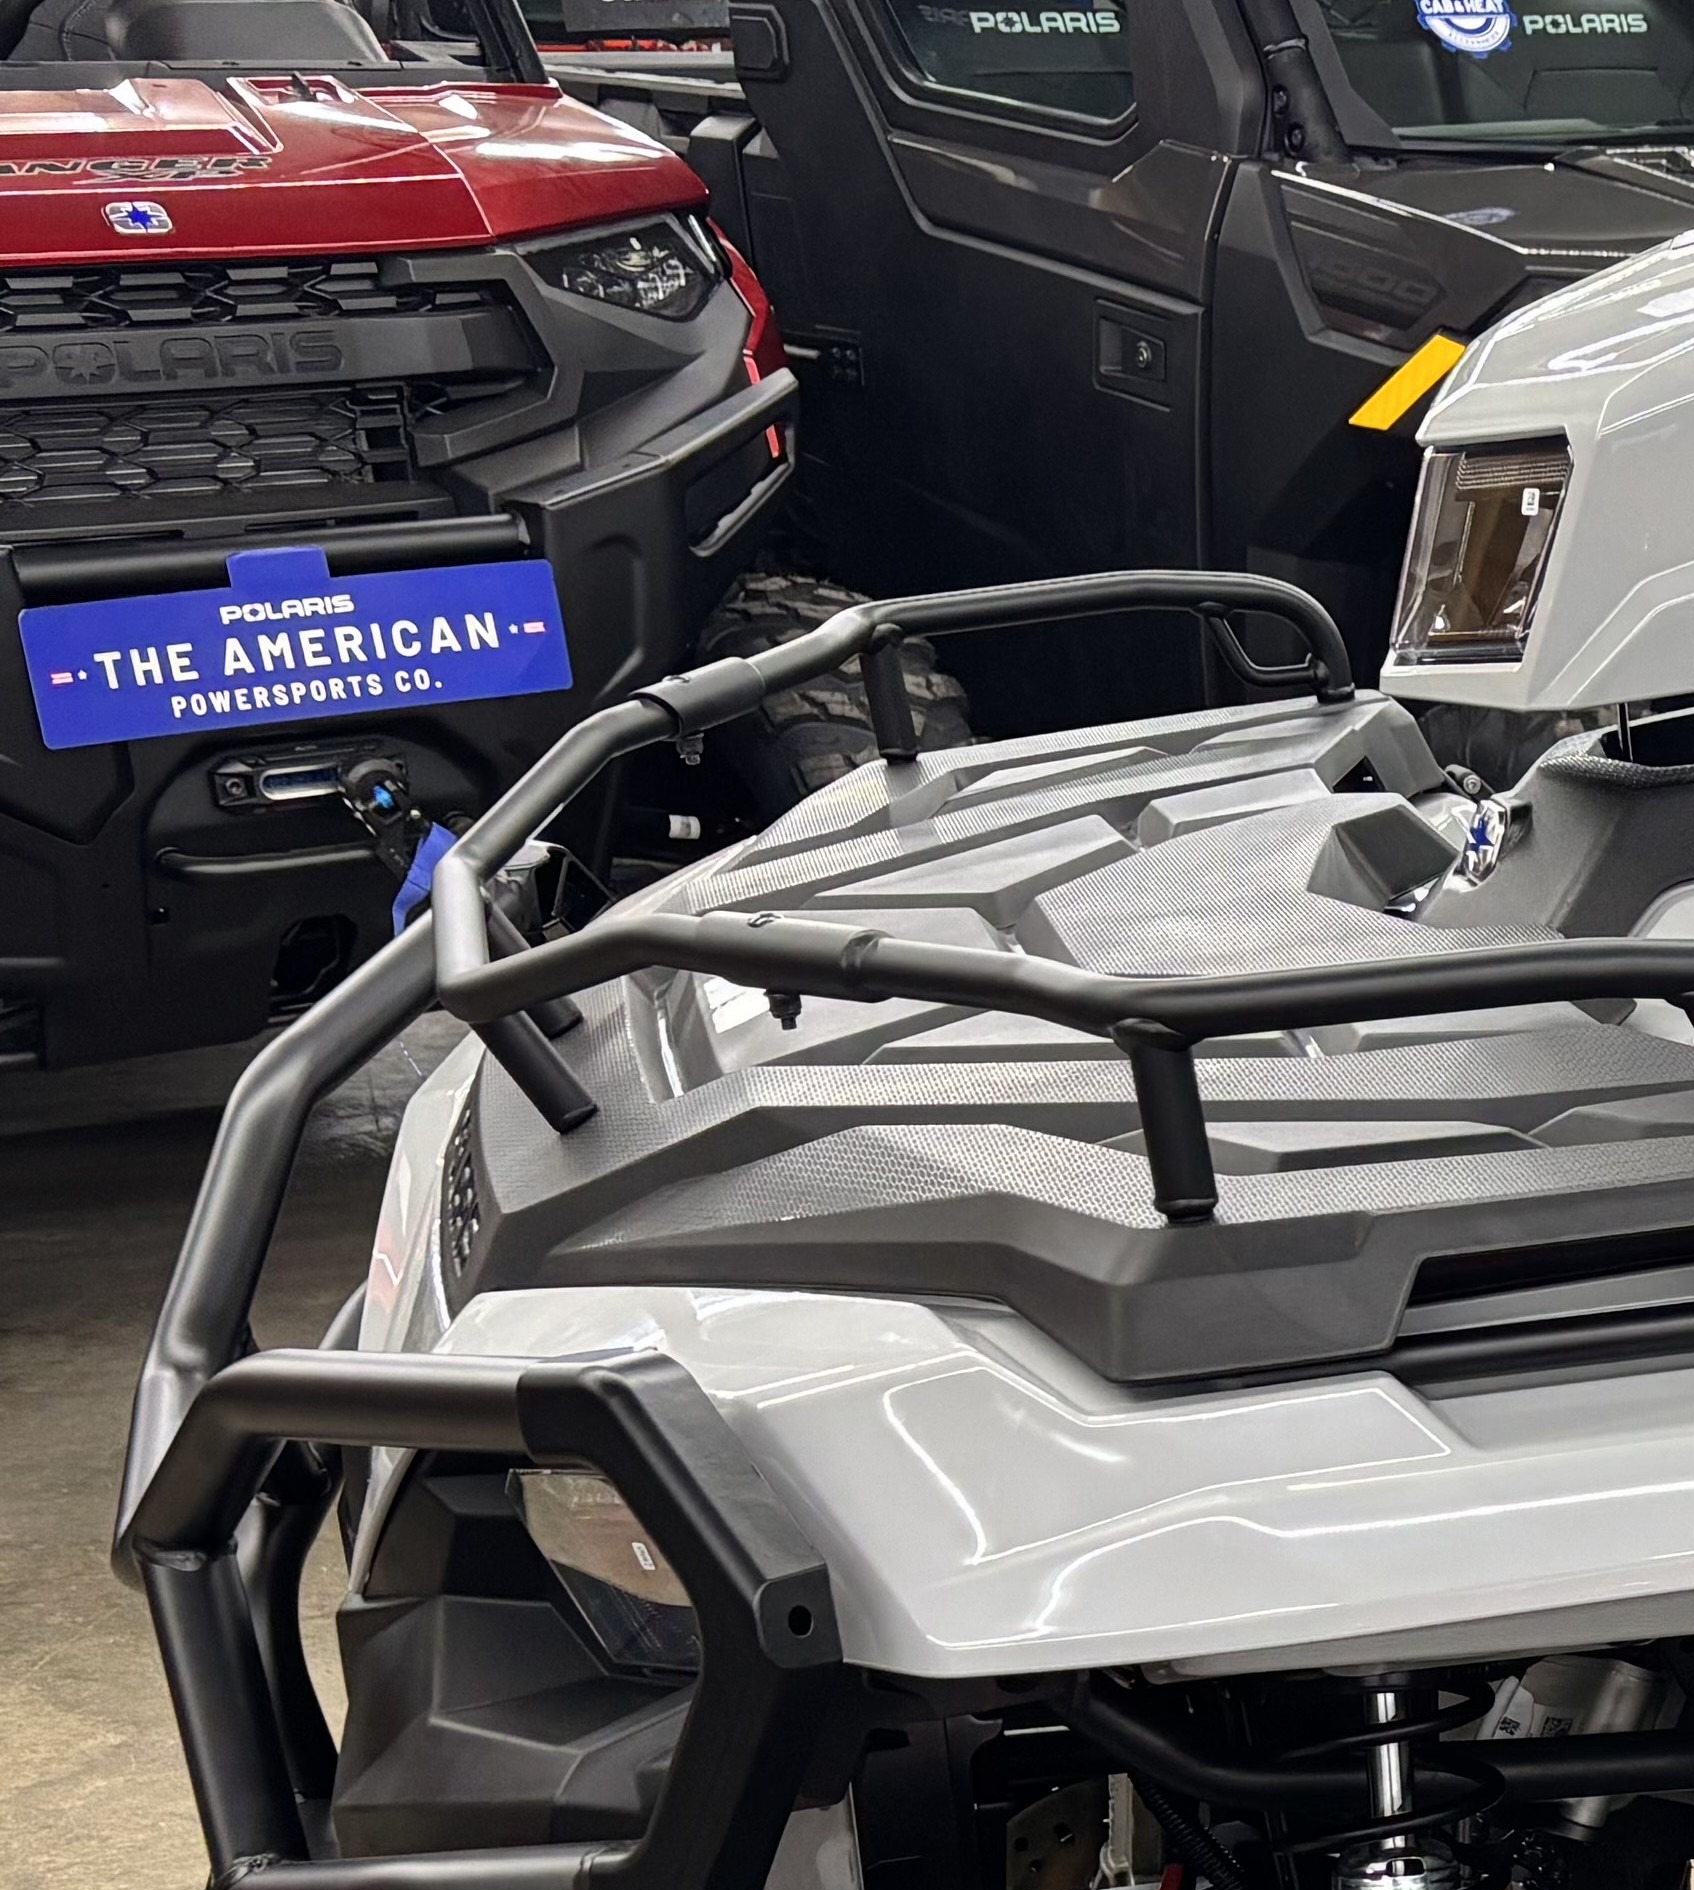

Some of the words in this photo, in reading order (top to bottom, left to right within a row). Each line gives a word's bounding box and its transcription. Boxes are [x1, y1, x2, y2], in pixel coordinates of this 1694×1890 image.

[969, 11, 1121, 33] POLARIS
[1523, 13, 1648, 35] POLARIS
[0, 330, 344, 390] POLARIS
[219, 594, 355, 625] POLARIS
[93, 642, 200, 690] THE
[223, 611, 501, 677] AMERICAN
[171, 672, 383, 719] POWERSPORTS
[394, 667, 444, 693] CO.
